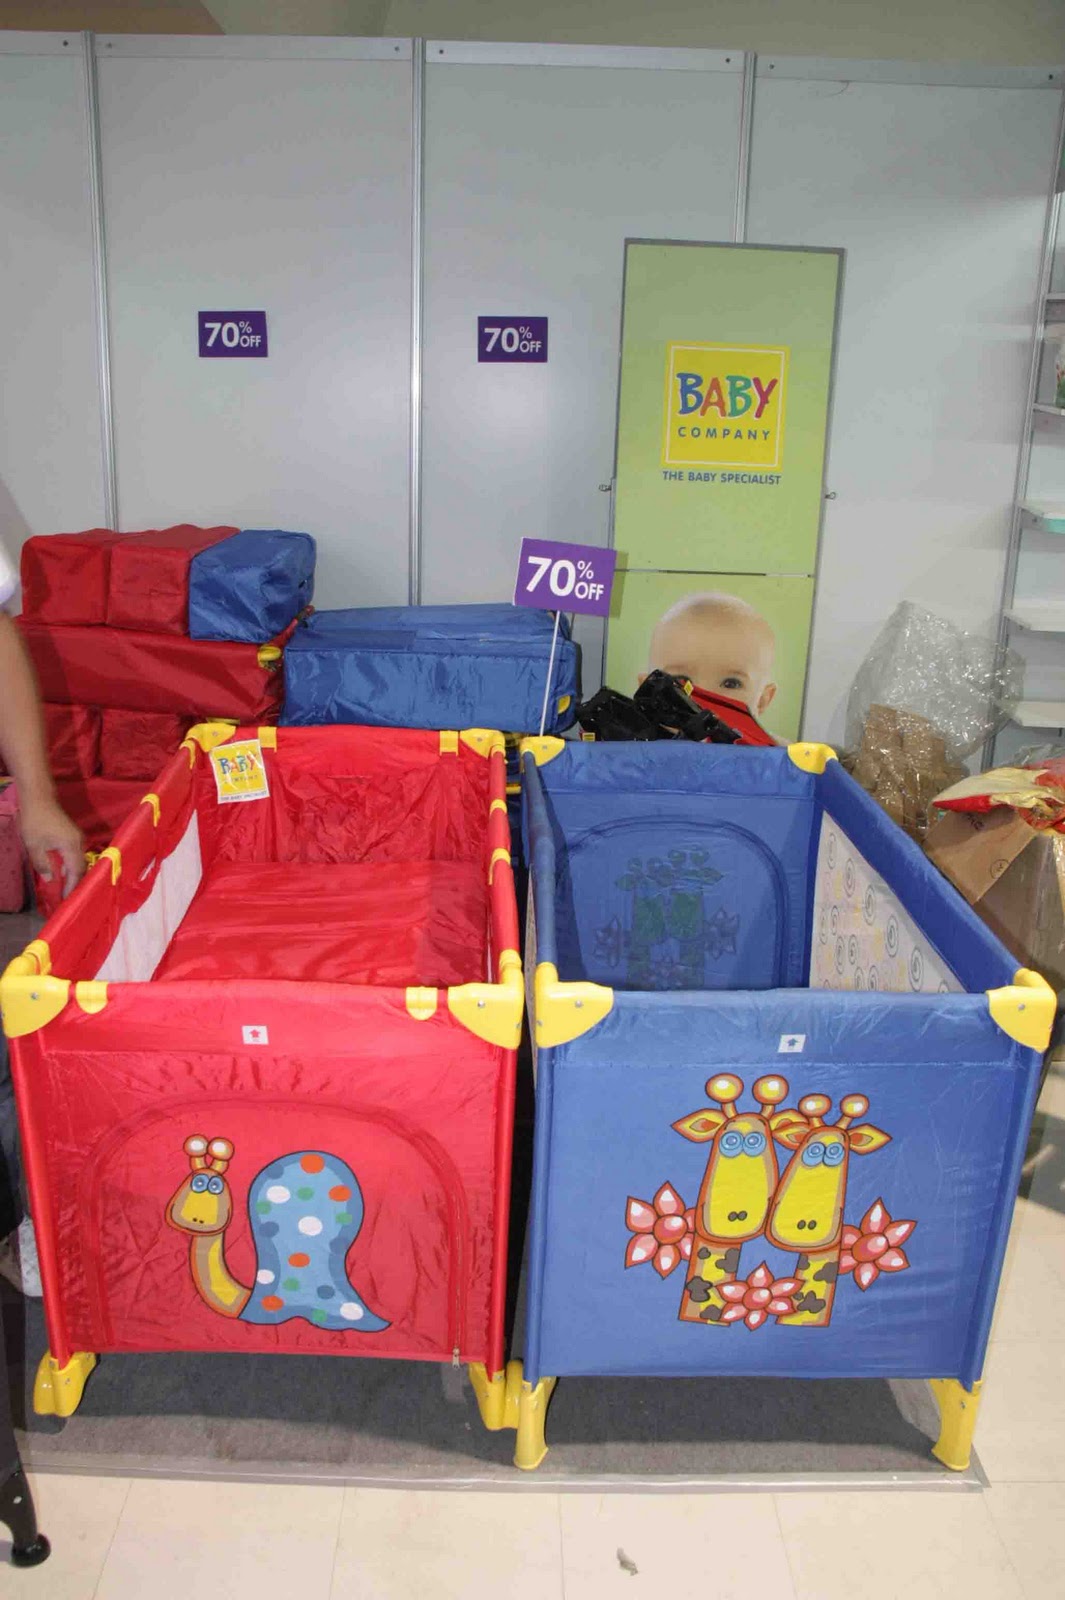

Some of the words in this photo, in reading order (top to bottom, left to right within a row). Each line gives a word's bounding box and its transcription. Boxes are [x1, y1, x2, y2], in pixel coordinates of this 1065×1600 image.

[240, 335, 262, 348] OFF
[519, 341, 542, 353] OFF
[676, 372, 778, 419] BABY
[677, 426, 770, 441] COMPANY
[662, 470, 684, 481] THE
[688, 471, 717, 483] BABY
[720, 473, 782, 485] SPECIALIST
[574, 581, 604, 601] OFF
[217, 753, 257, 775] BABY
